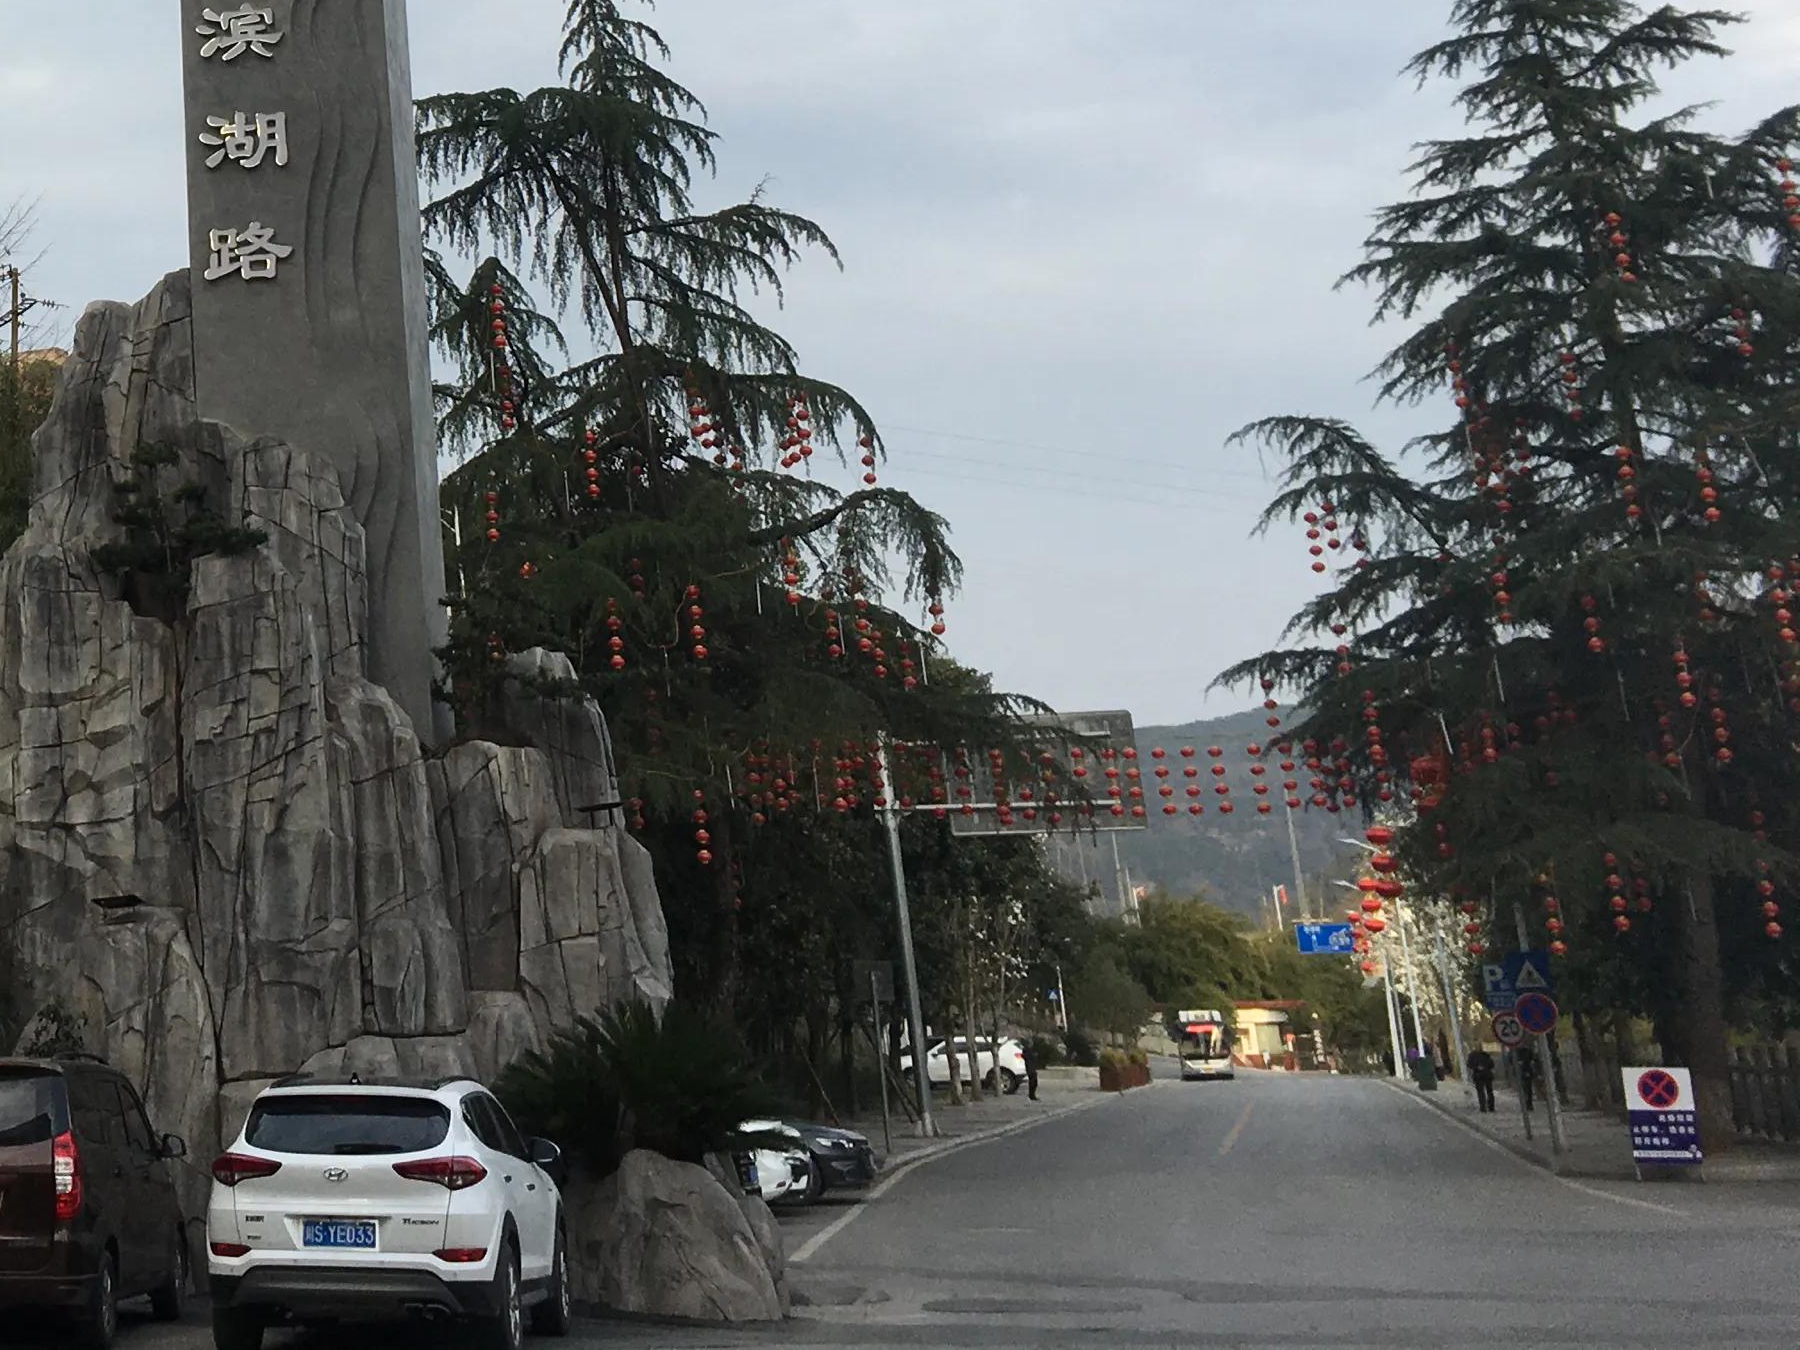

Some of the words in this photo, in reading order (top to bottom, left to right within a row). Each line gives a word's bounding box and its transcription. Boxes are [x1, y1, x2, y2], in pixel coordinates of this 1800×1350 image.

[195, 2, 293, 282] 滨湖路
[1482, 964, 1505, 991] P
[1500, 1019, 1520, 1038] 20
